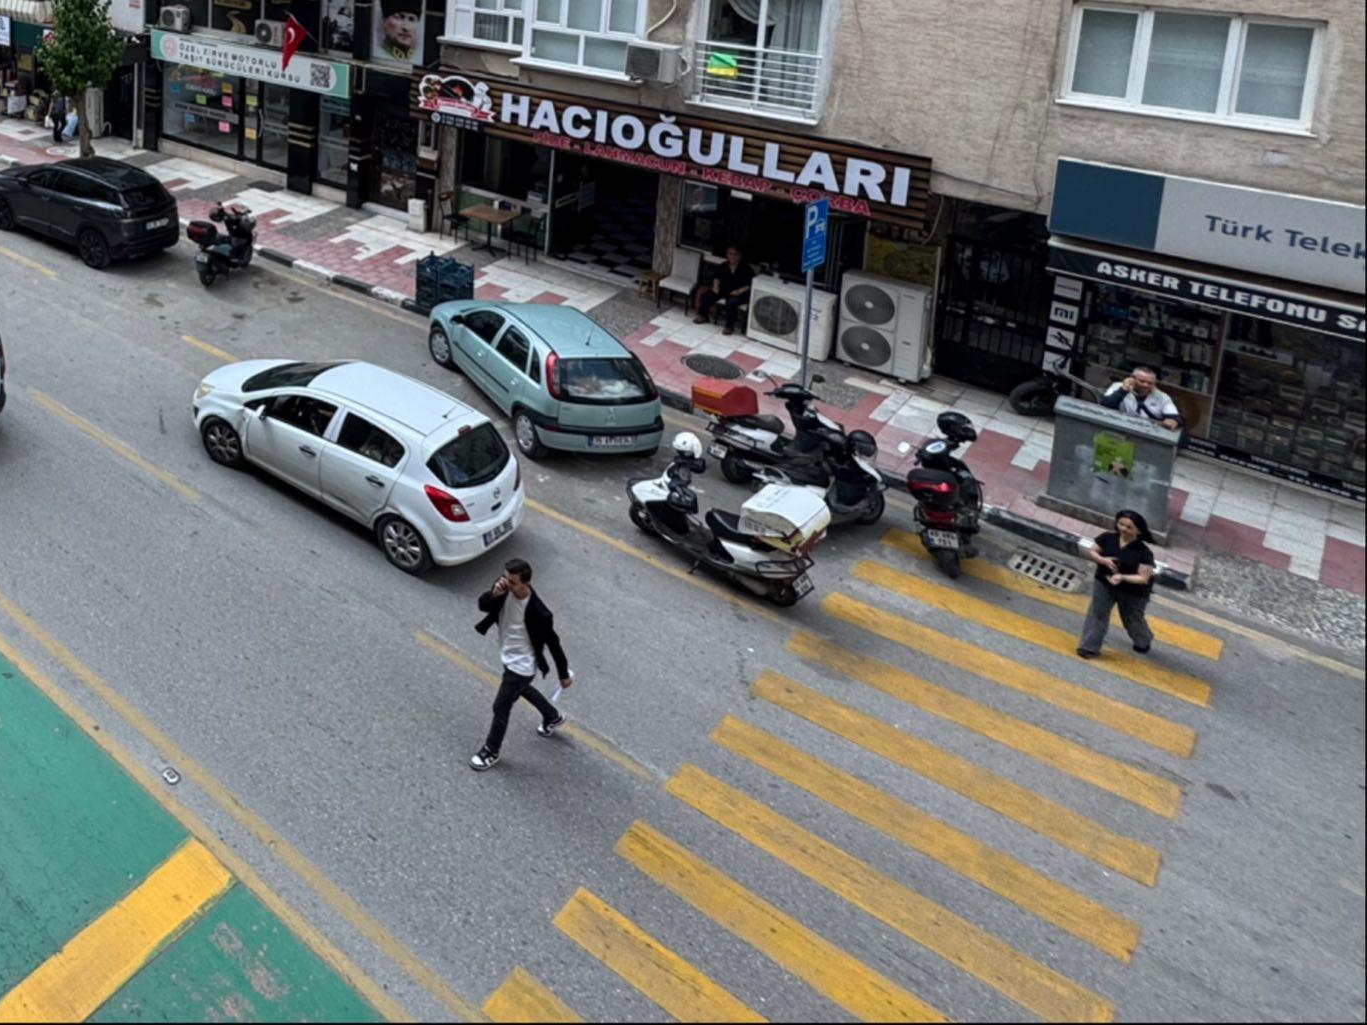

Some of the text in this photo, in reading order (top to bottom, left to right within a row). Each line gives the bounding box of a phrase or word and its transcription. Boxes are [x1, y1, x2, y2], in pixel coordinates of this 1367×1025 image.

[231, 53, 277, 69] MOTORLU
[500, 92, 911, 207] HACIOĞULLARI
[701, 167, 772, 193] KEBAP
[805, 205, 819, 239] P
[1205, 214, 1273, 243] Türk
[1097, 261, 1179, 290] ASKER
[1189, 280, 1328, 324] TELEFONU
